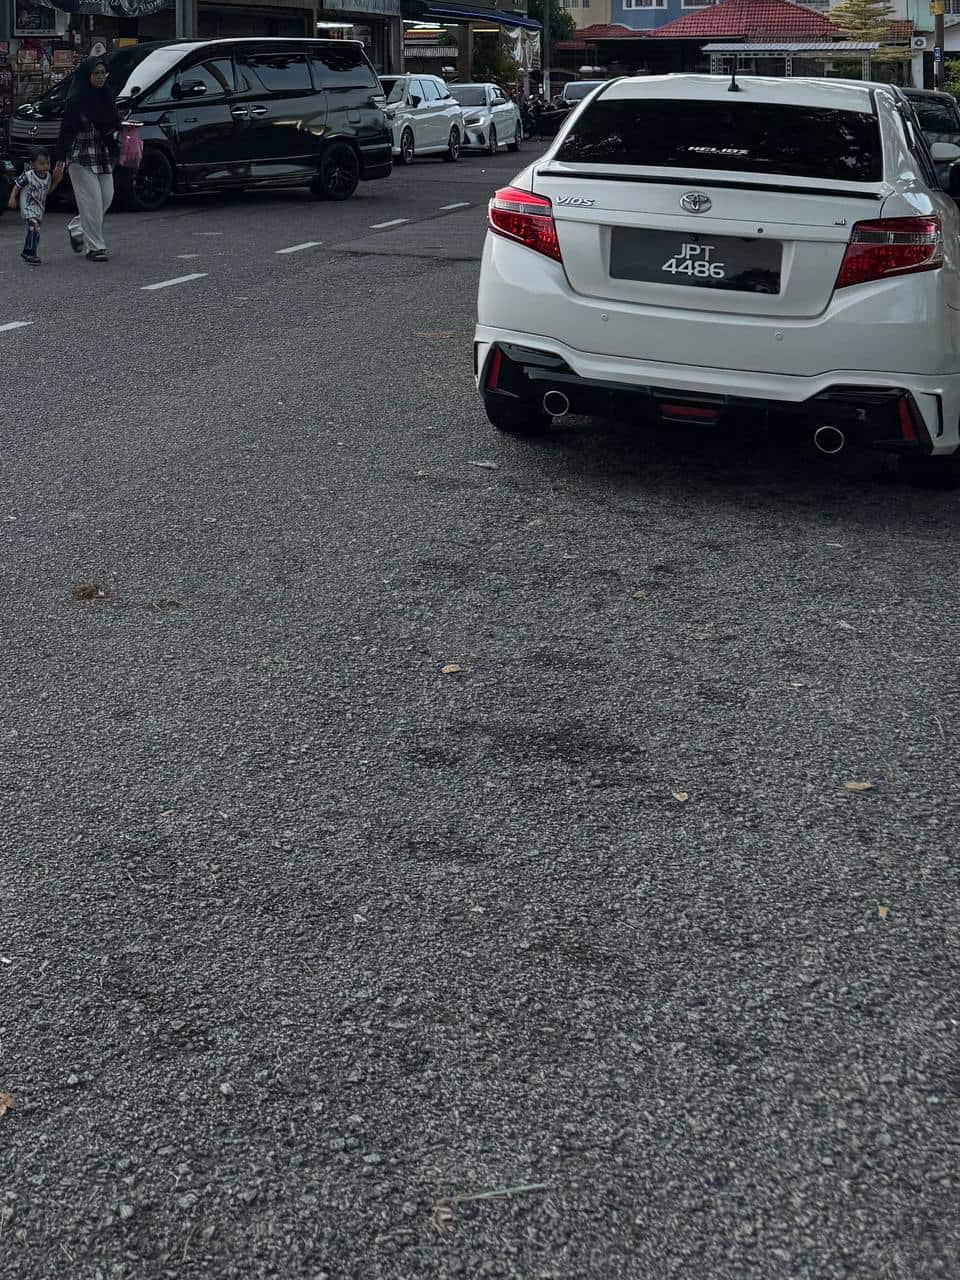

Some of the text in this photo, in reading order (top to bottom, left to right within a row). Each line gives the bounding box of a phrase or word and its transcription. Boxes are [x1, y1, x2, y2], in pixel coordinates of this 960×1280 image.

[555, 195, 595, 206] VIOS
[674, 243, 715, 261] JPT
[661, 258, 725, 279] 4486
